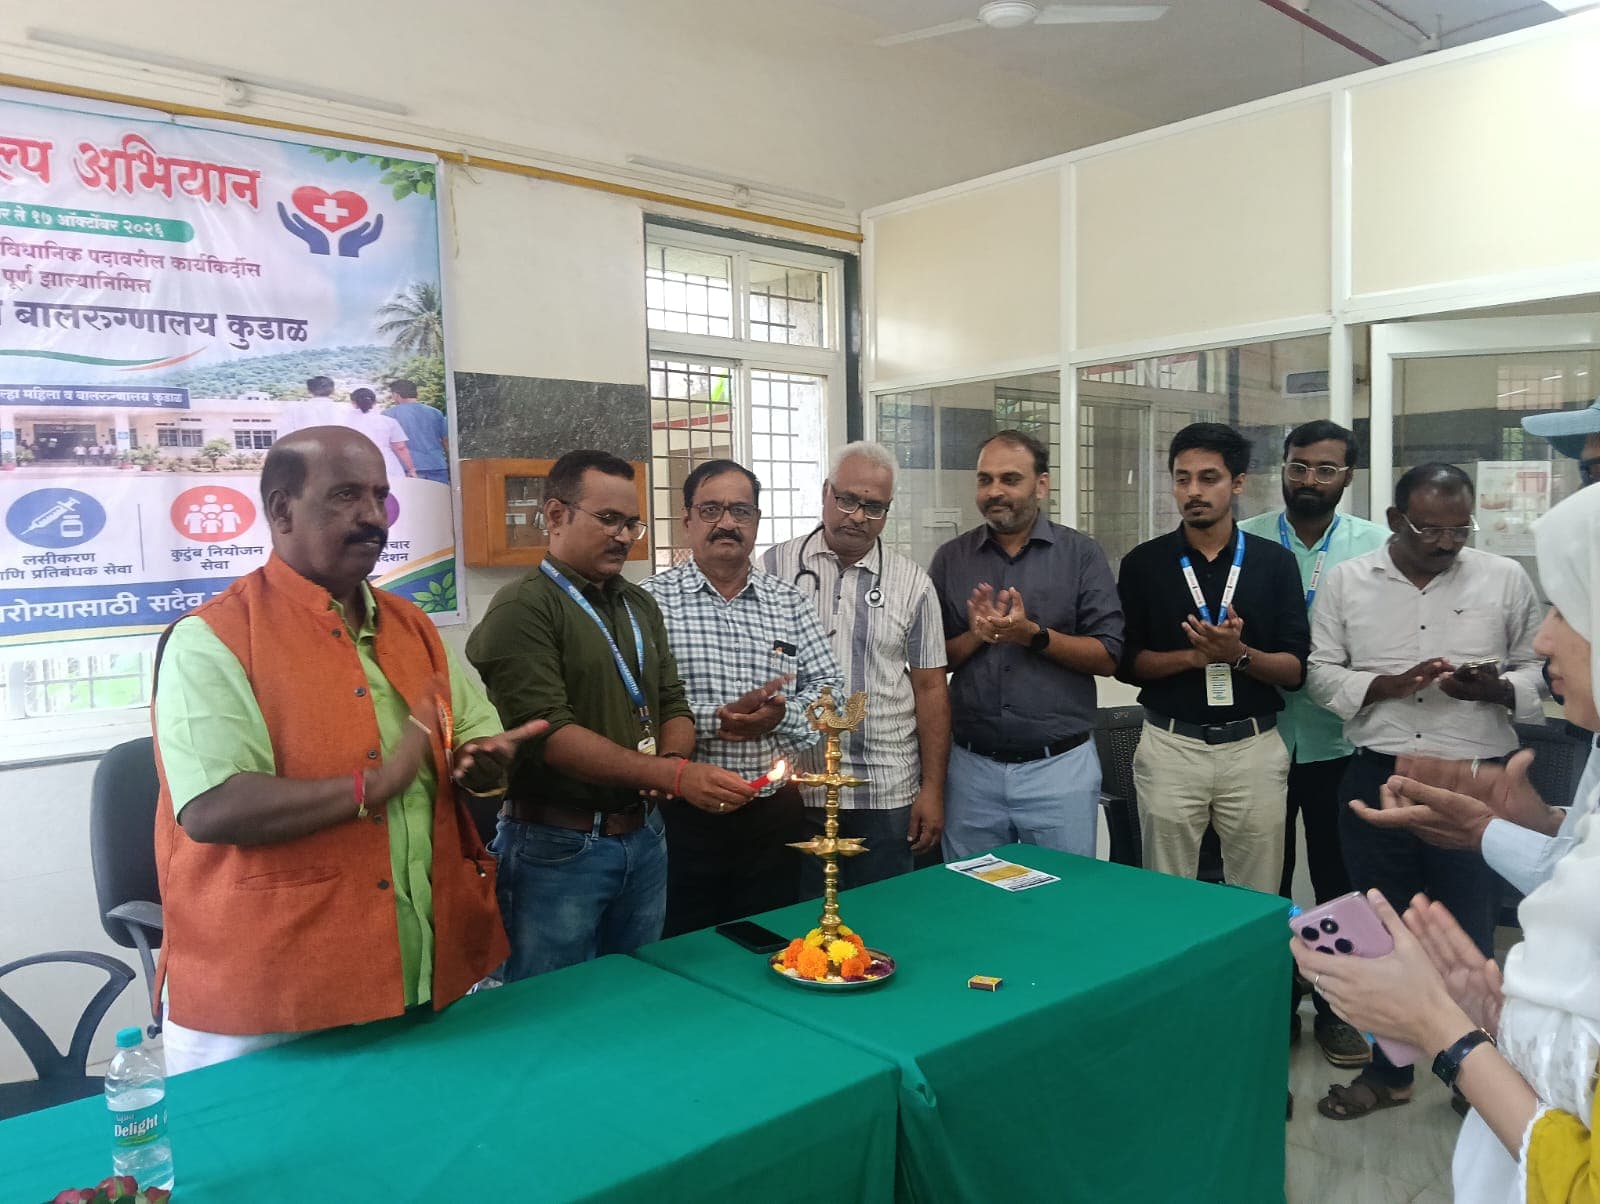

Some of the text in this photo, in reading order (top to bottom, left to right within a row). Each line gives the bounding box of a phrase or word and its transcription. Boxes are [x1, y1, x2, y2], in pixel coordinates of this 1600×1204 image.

[74, 133, 261, 209] अभियान
[31, 210, 53, 225] १७
[88, 249, 165, 269] पदावरील
[2, 264, 151, 294] पूर्ण झाल्यानिमित्त
[13, 300, 217, 337] बालरुग्णालय
[226, 314, 308, 350] कुडाळ
[22, 386, 61, 402] महिला
[22, 551, 96, 566] लसीकरण
[171, 544, 264, 562] कुटुंब नियोजन
[31, 565, 98, 579] प्रतिबंधक
[103, 563, 133, 575] सेवा
[200, 558, 230, 571] सेवा
[146, 587, 206, 613] सदैव
[114, 1113, 158, 1137] Delight
